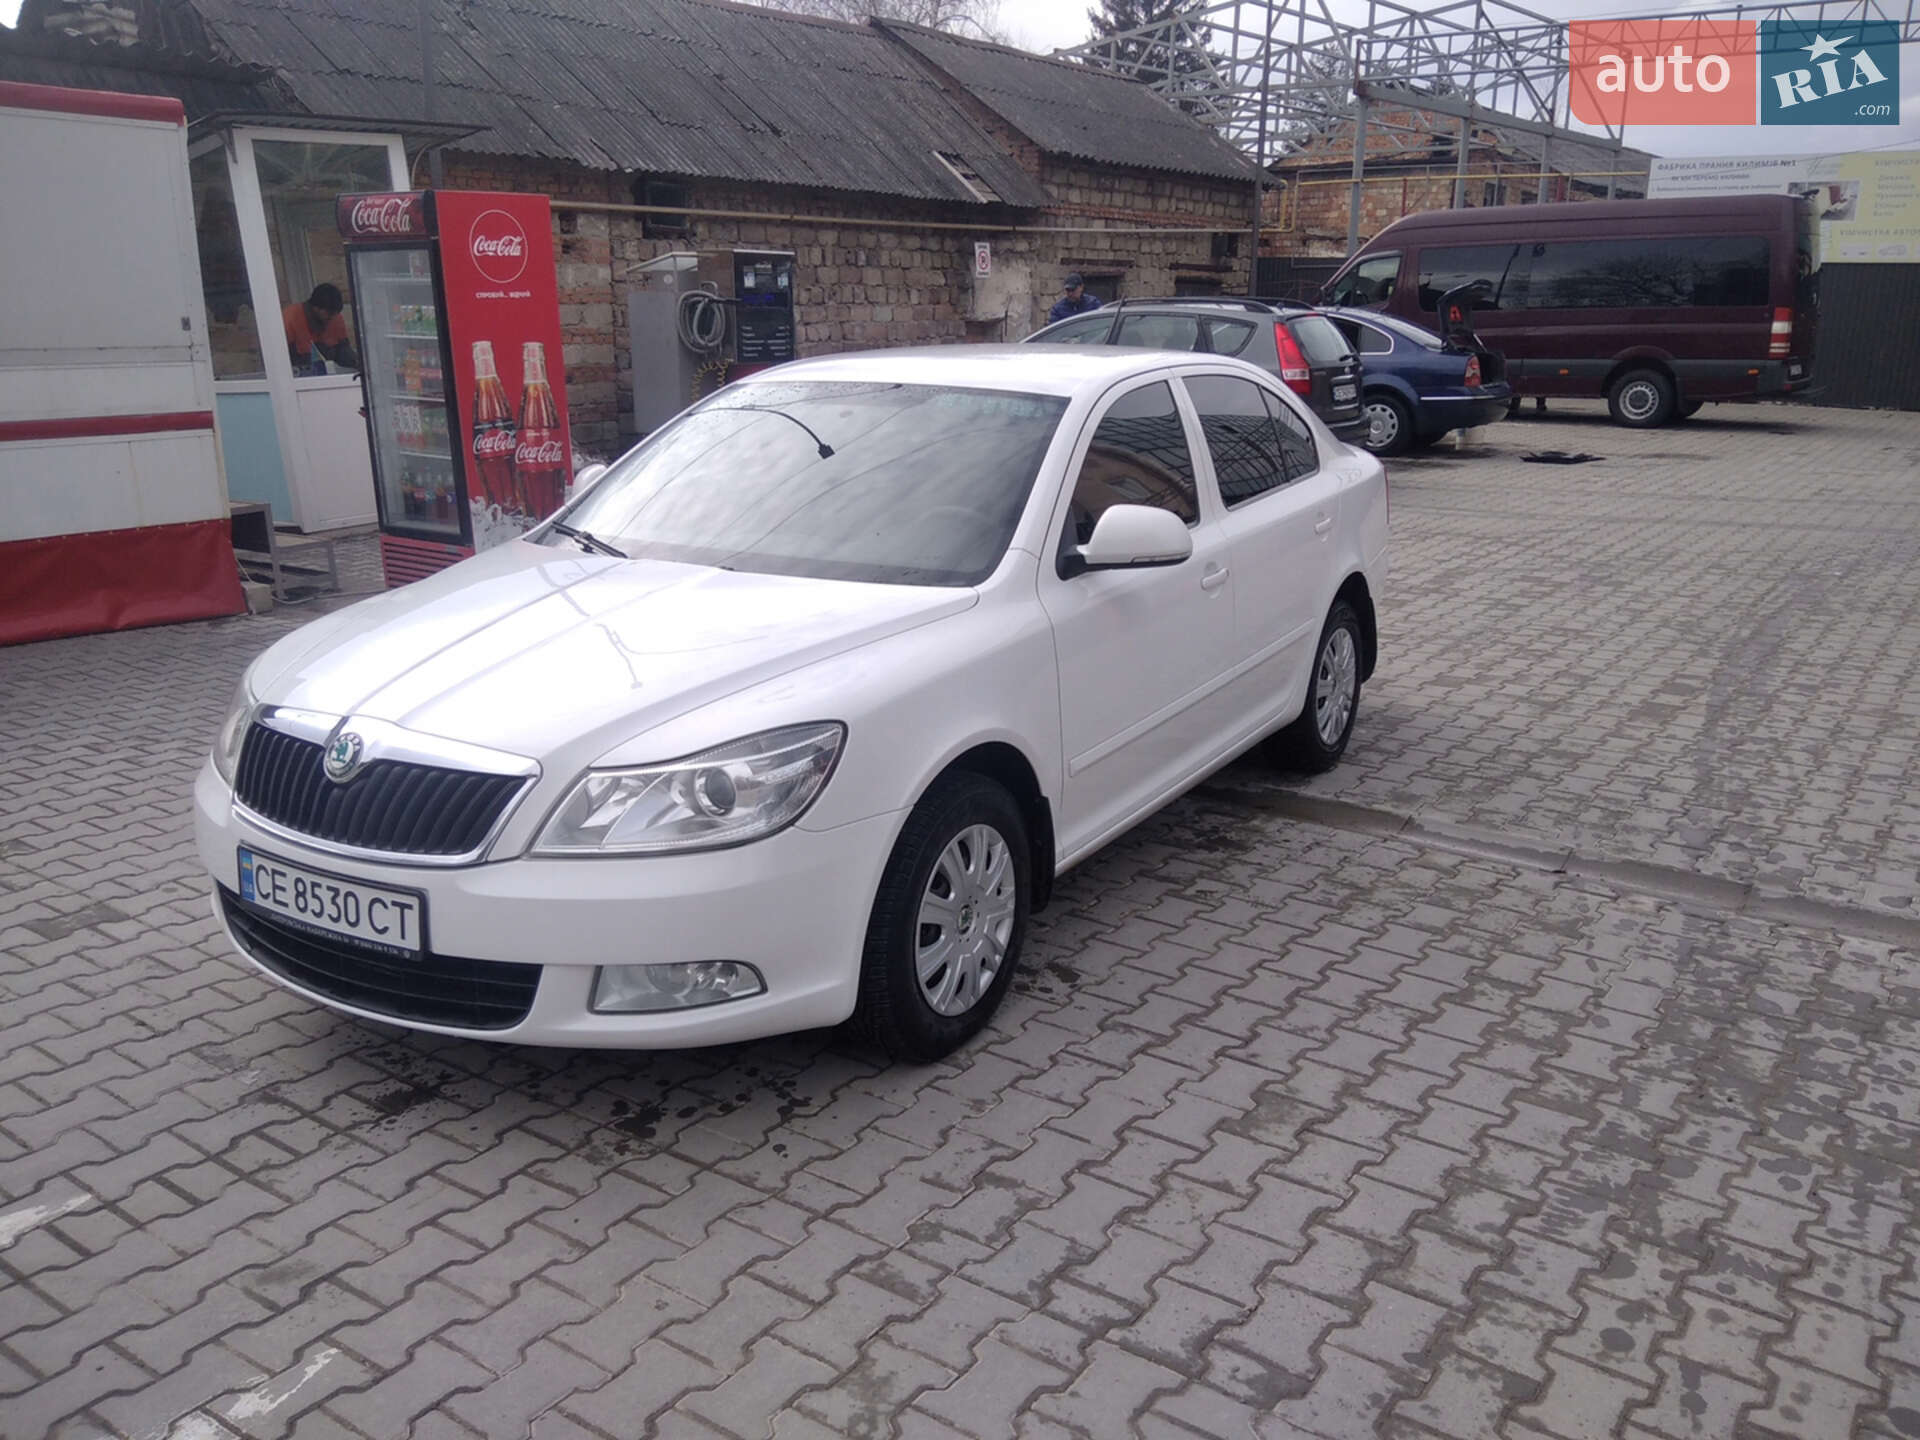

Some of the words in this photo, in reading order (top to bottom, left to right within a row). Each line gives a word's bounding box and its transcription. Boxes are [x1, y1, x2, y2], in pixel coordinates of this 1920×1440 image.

[351, 198, 416, 234] Coca-Cola
[473, 234, 524, 257] Coca-Cola
[472, 429, 517, 455] Coca-Cola
[515, 440, 563, 465] Coca-Cola
[254, 864, 289, 909] CE
[293, 876, 361, 929] 8530
[367, 896, 414, 941] CT
